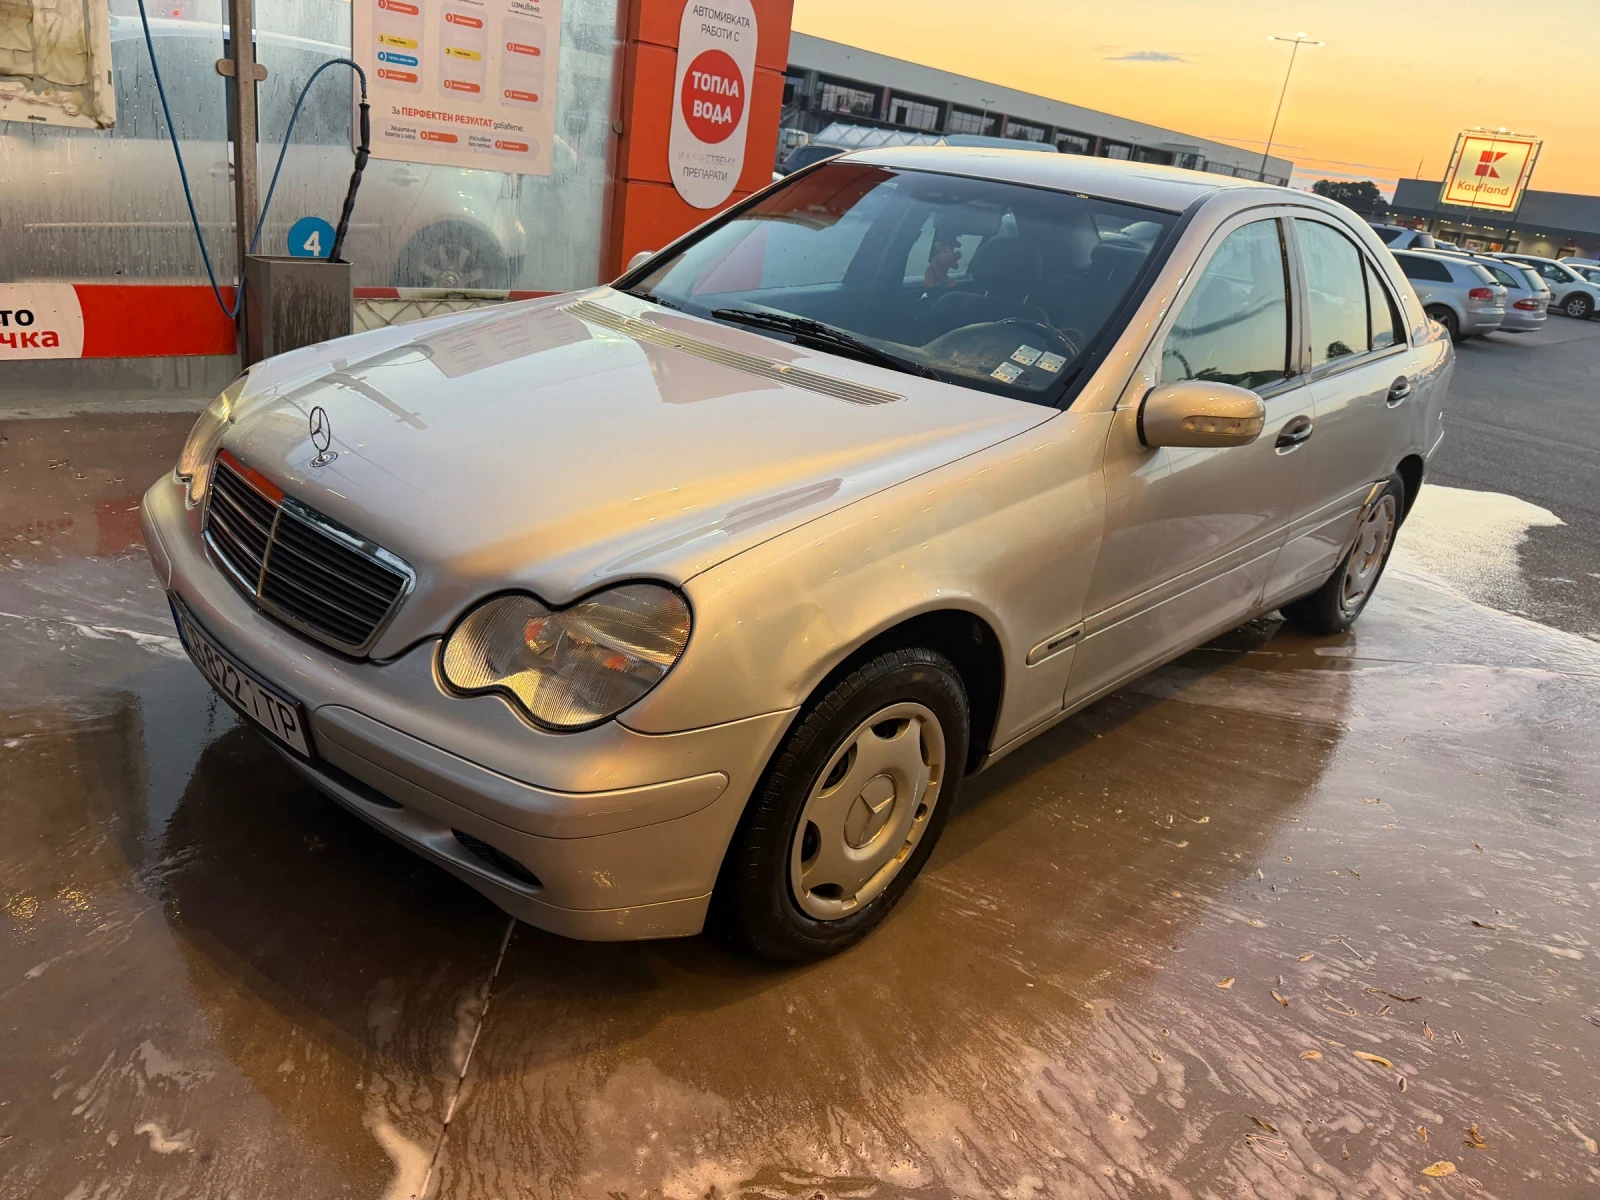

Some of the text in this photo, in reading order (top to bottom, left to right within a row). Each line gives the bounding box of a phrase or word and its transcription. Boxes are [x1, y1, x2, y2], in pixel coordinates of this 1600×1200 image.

[511, 1, 540, 13] измиване
[692, 4, 750, 28] АВТОМИВКАТА
[701, 23, 740, 42] РАБОТИ С
[692, 70, 739, 98] ТОПЛА
[391, 106, 524, 132] За ПЕРФЕКТЕН РЕЗУЛТАТ добавете:
[693, 99, 732, 124] ВОДА
[687, 152, 736, 168] КАСТВЕНИ
[683, 166, 728, 181] ПРЕПАРАТИ
[1457, 180, 1509, 196] Kaufland
[303, 231, 321, 256] 4
[258, 688, 297, 741] TP
